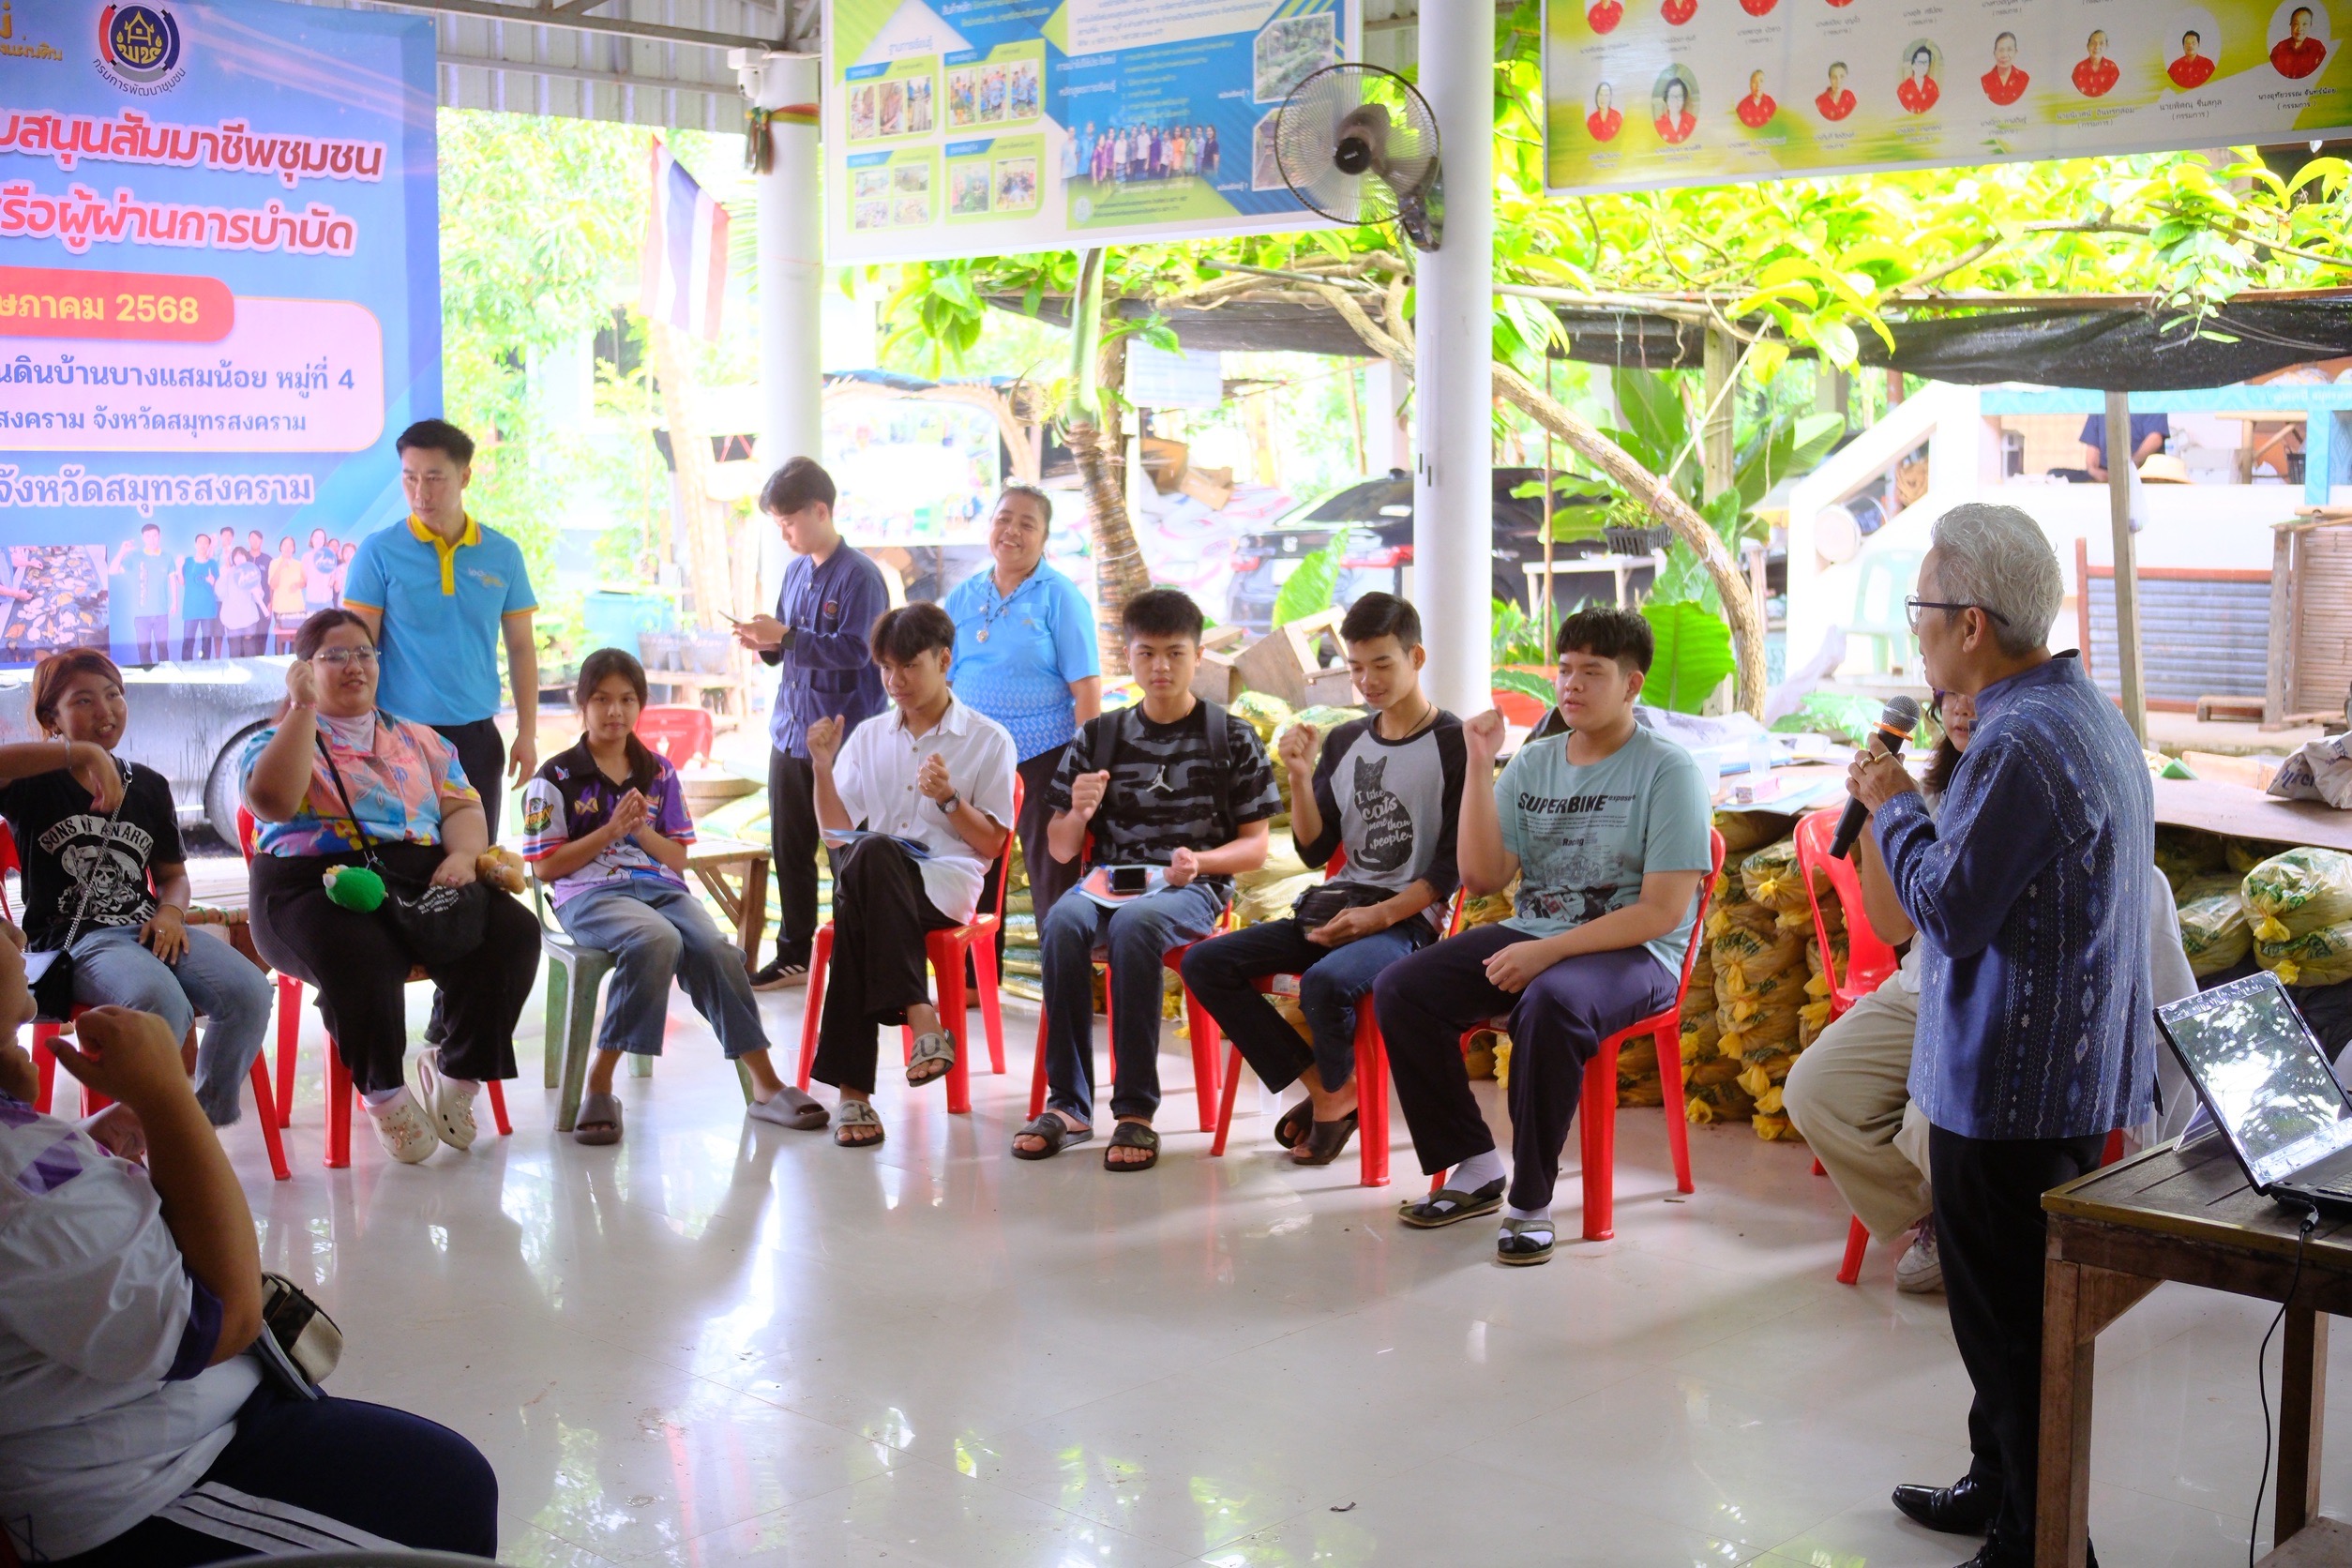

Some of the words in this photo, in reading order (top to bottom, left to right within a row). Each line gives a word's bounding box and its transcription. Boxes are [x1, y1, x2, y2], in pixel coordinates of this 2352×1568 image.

[93, 58, 187, 97] กรมการพัฒนาชุมชน
[0, 186, 354, 250] รือผู้ผ่านการบำบัด
[115, 294, 200, 324] 2568
[276, 355, 329, 400] หมู่ที่
[338, 369, 354, 390] 4
[92, 405, 307, 439] จังหวัดสมุทรสงคราม
[1356, 791, 1363, 806] I
[1366, 789, 1386, 802] like
[1361, 797, 1398, 821] cats
[1517, 792, 1609, 814] SUPERBIKE
[40, 819, 77, 851] SONS
[1368, 818, 1387, 832] more
[1387, 817, 1411, 831] than
